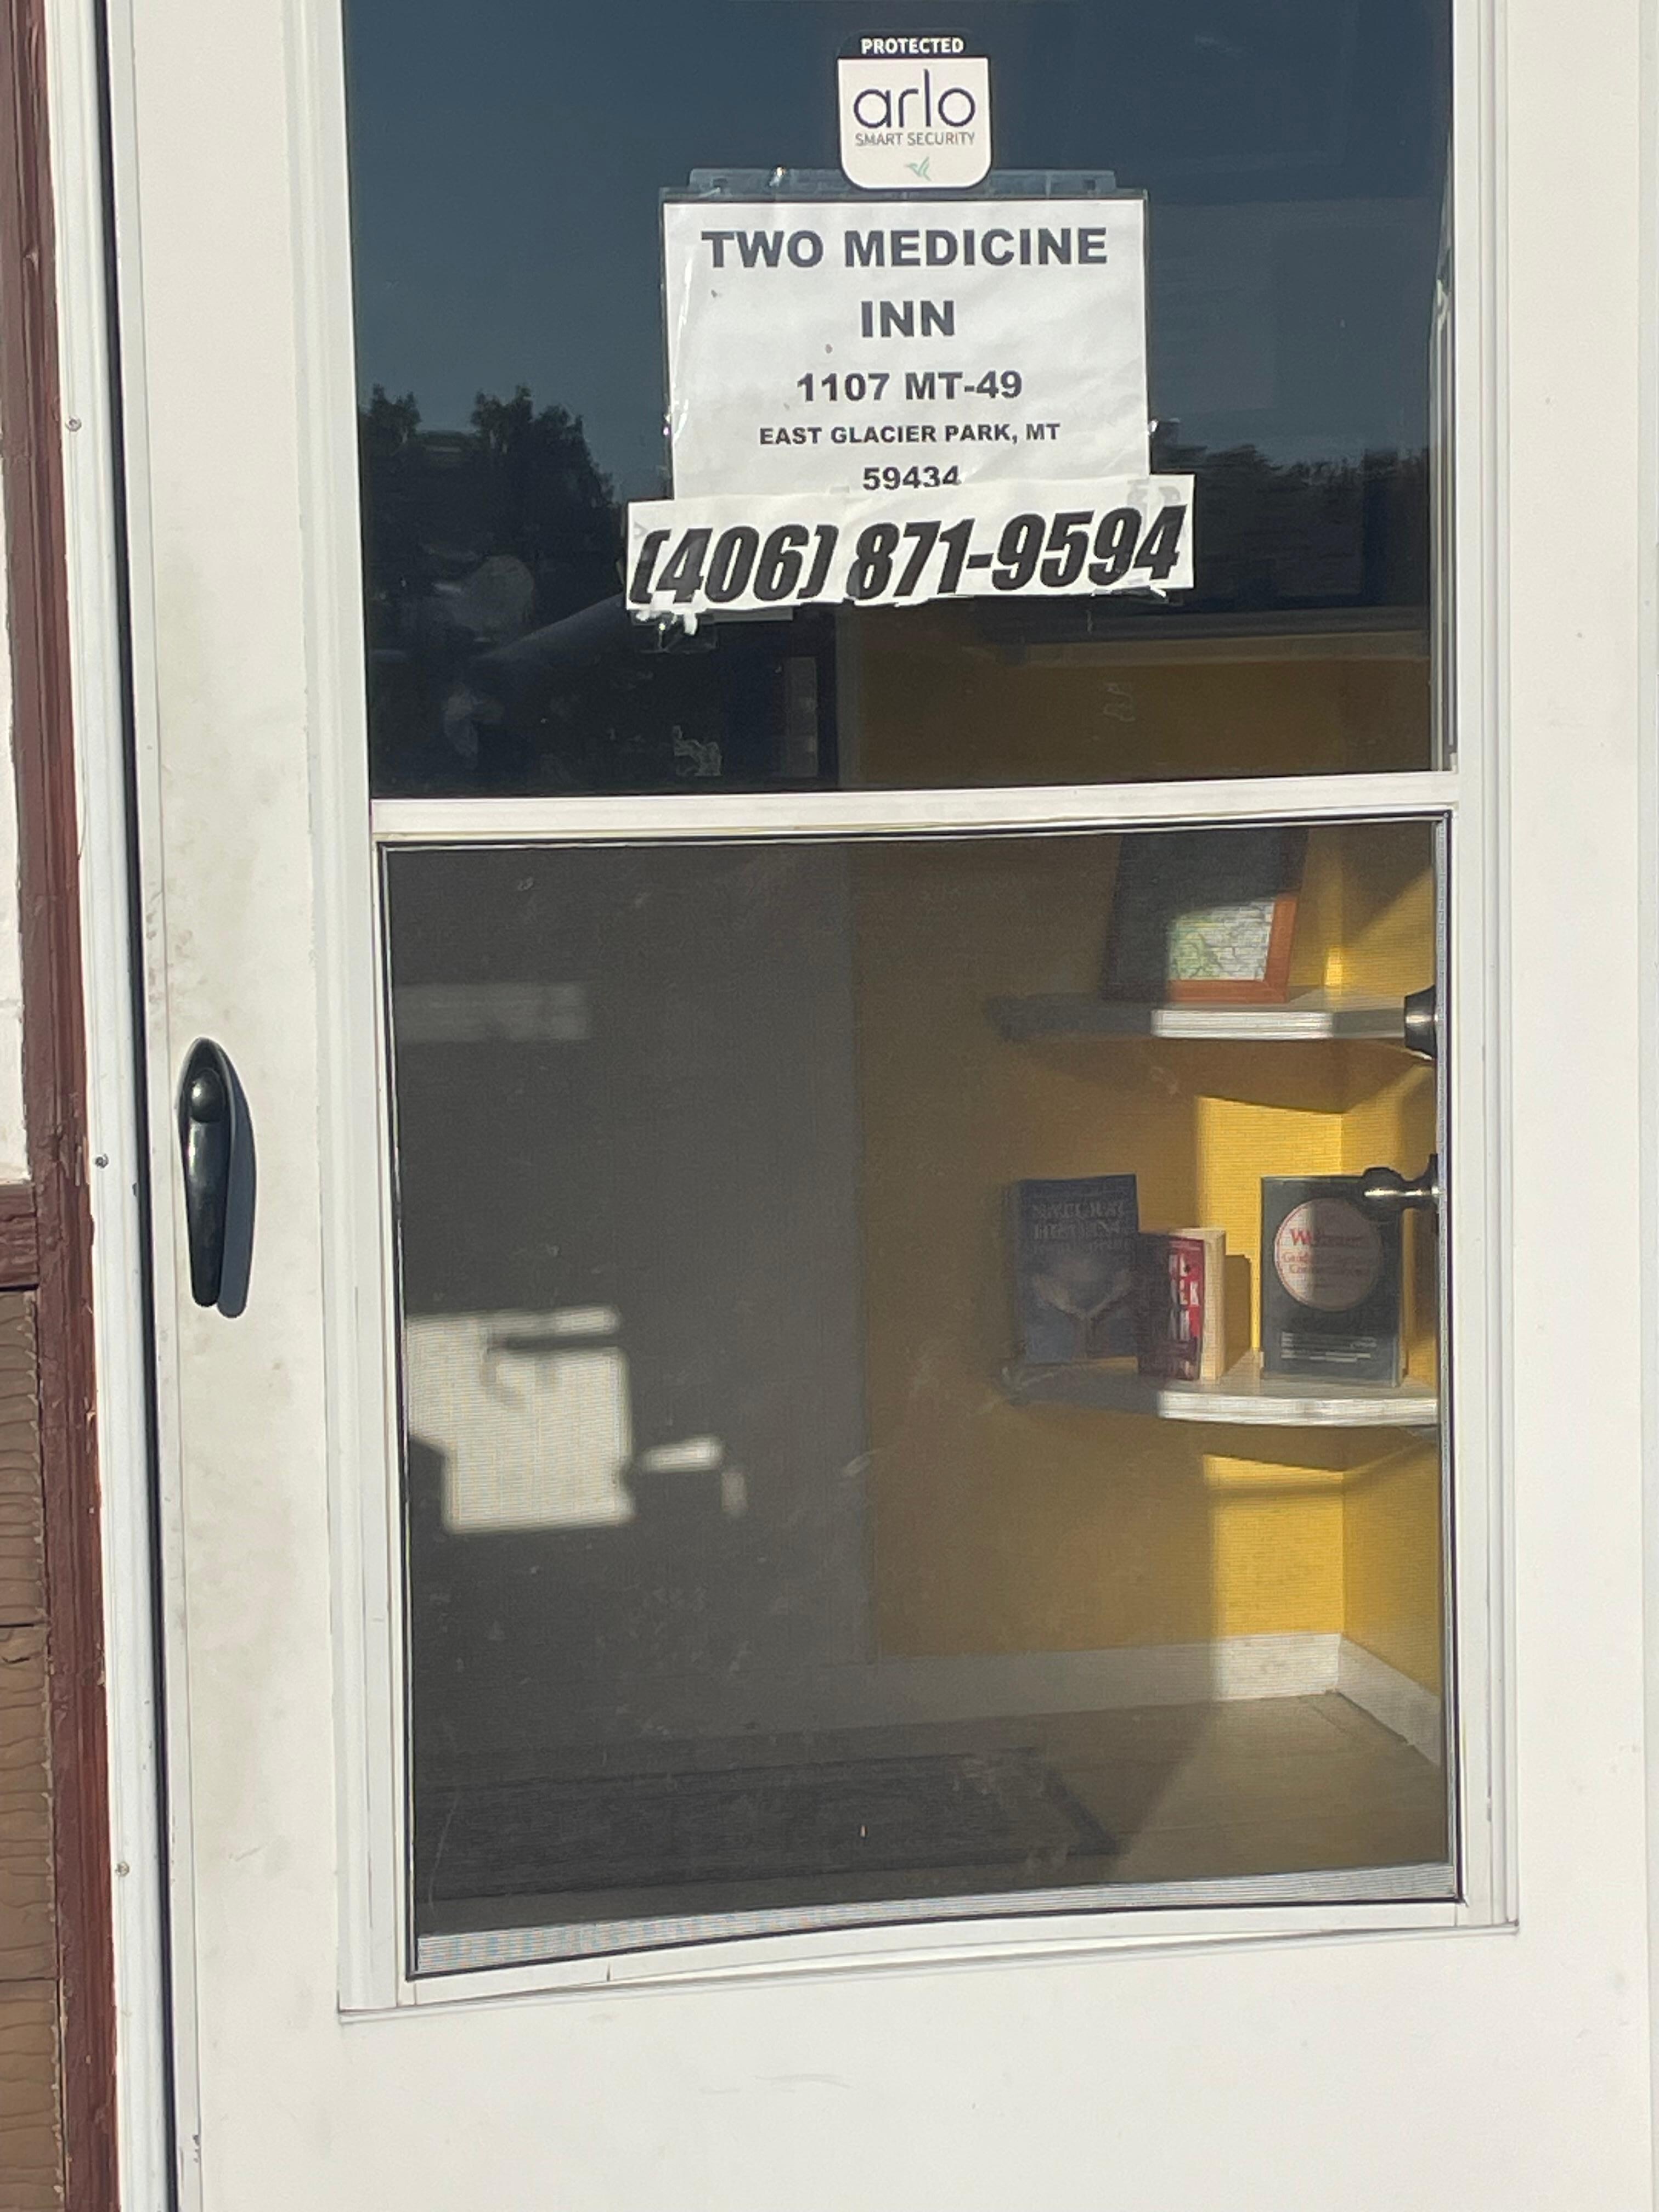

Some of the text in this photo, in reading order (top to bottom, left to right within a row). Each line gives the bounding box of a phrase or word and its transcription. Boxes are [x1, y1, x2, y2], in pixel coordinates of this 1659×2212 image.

[861, 37, 964, 54] PROTECTED
[853, 69, 975, 128] arlo
[855, 132, 975, 146] SMART SECURITY
[701, 227, 1108, 268] TWO MEDICINE
[861, 300, 955, 338] INN
[797, 370, 1023, 402] 1107 MT-49
[760, 423, 1060, 445] EAST GLACIER PARK, MT
[863, 465, 962, 490] 59434
[629, 504, 1188, 604] (406) 871-9594
